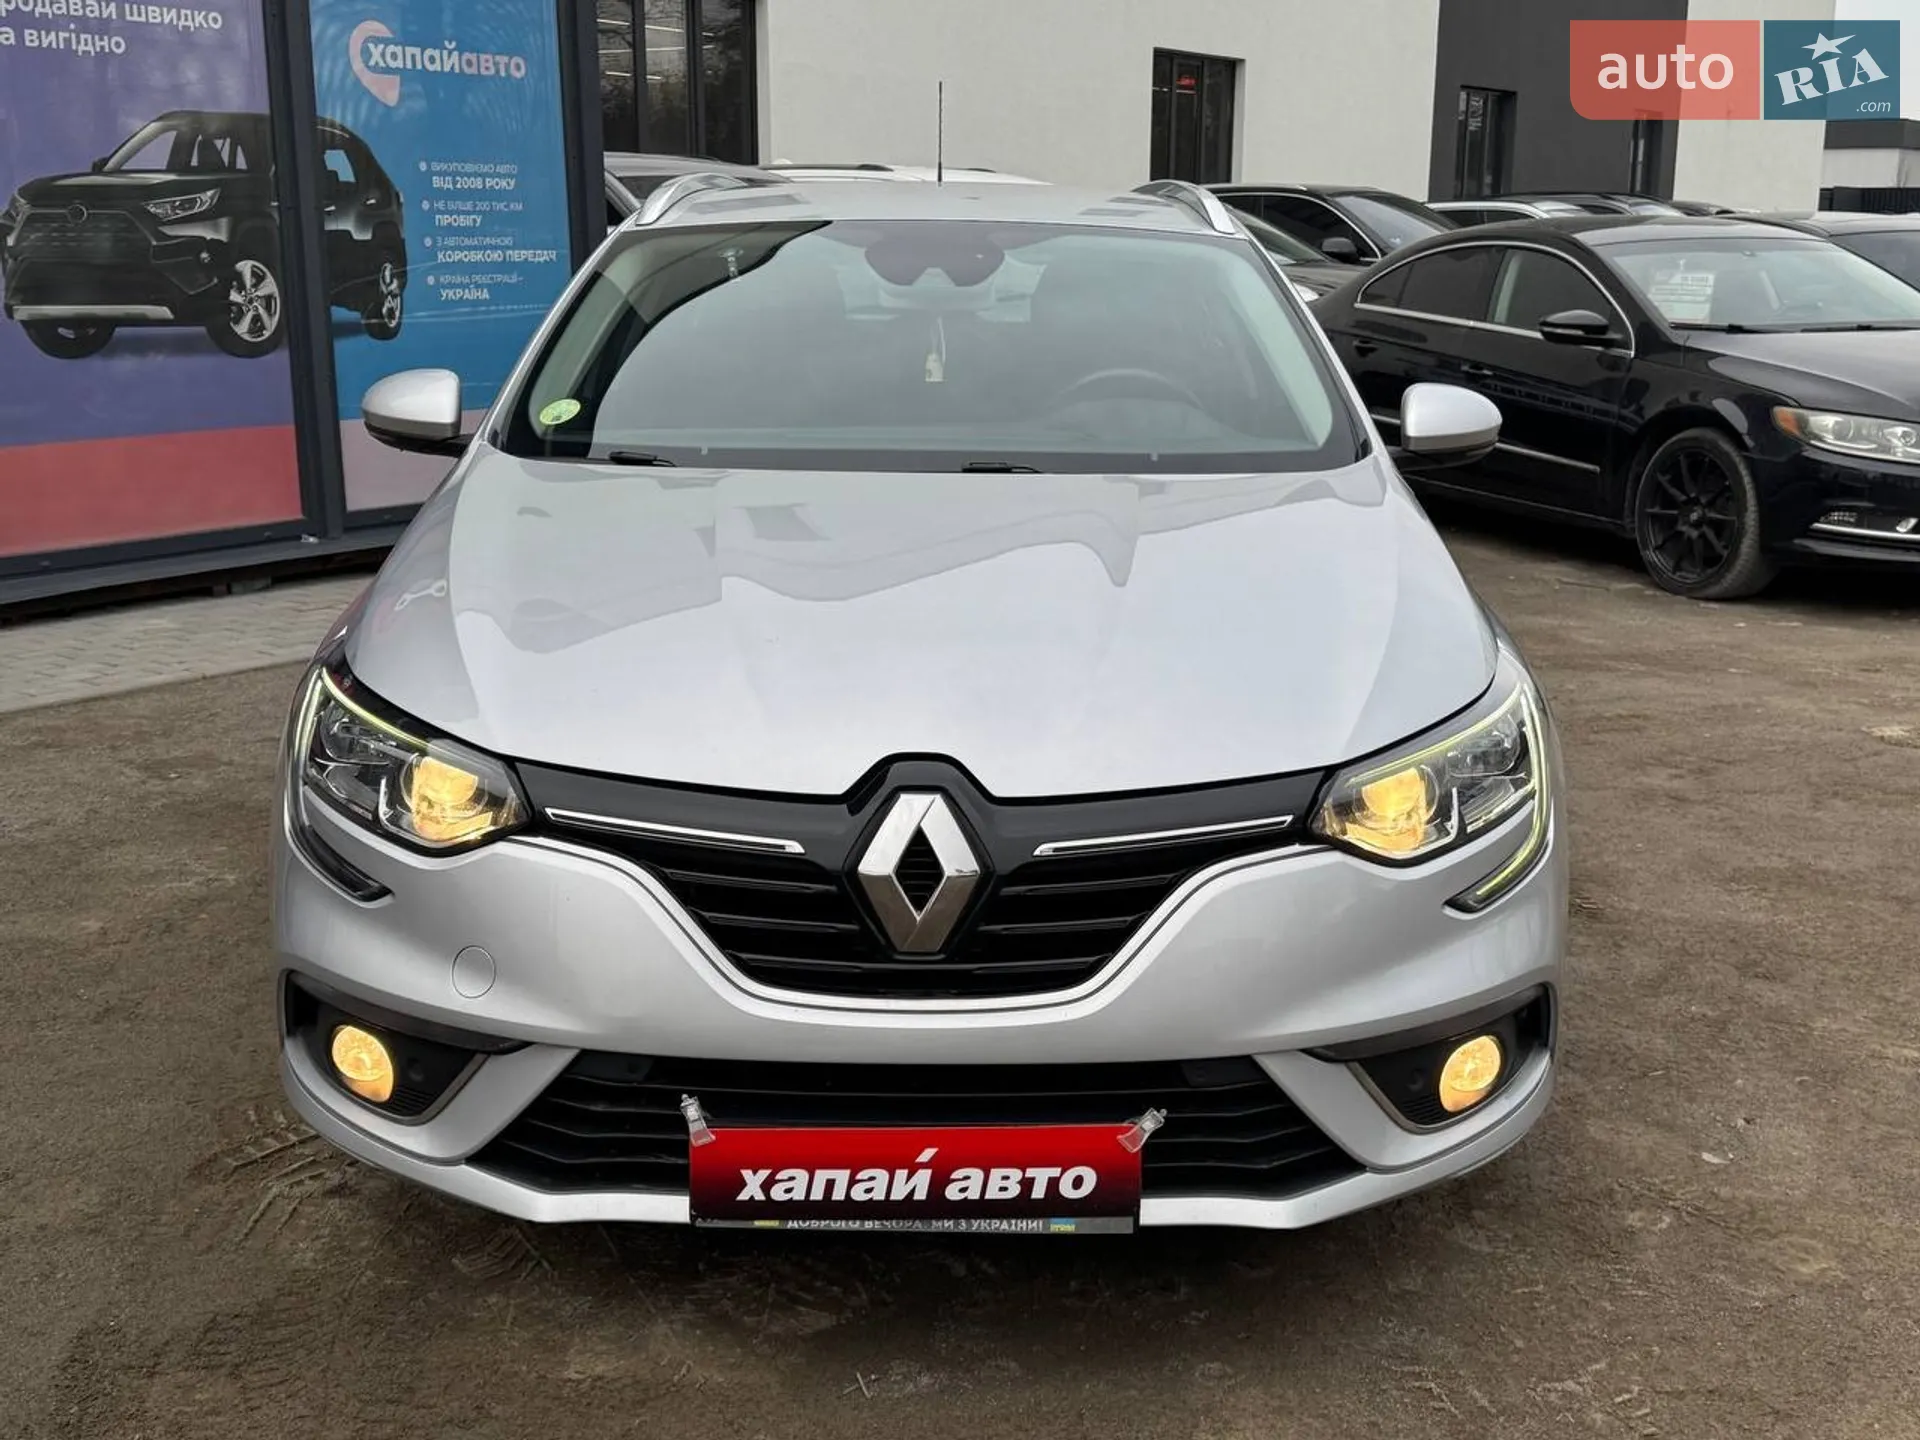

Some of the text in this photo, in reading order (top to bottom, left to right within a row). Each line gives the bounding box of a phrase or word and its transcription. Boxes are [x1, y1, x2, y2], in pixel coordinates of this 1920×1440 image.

[124, 3, 223, 31] швидко
[24, 23, 126, 56] вигідно
[432, 176, 516, 190] ВІД 2008 РОКУ
[433, 199, 446, 210] НЕ
[435, 214, 482, 227] ПРОБІГУ
[436, 250, 557, 263] КОРОБКОЮ ПЕРЕДАЧ
[440, 285, 490, 300] УКРАЇНА
[945, 1165, 1097, 1200] авто
